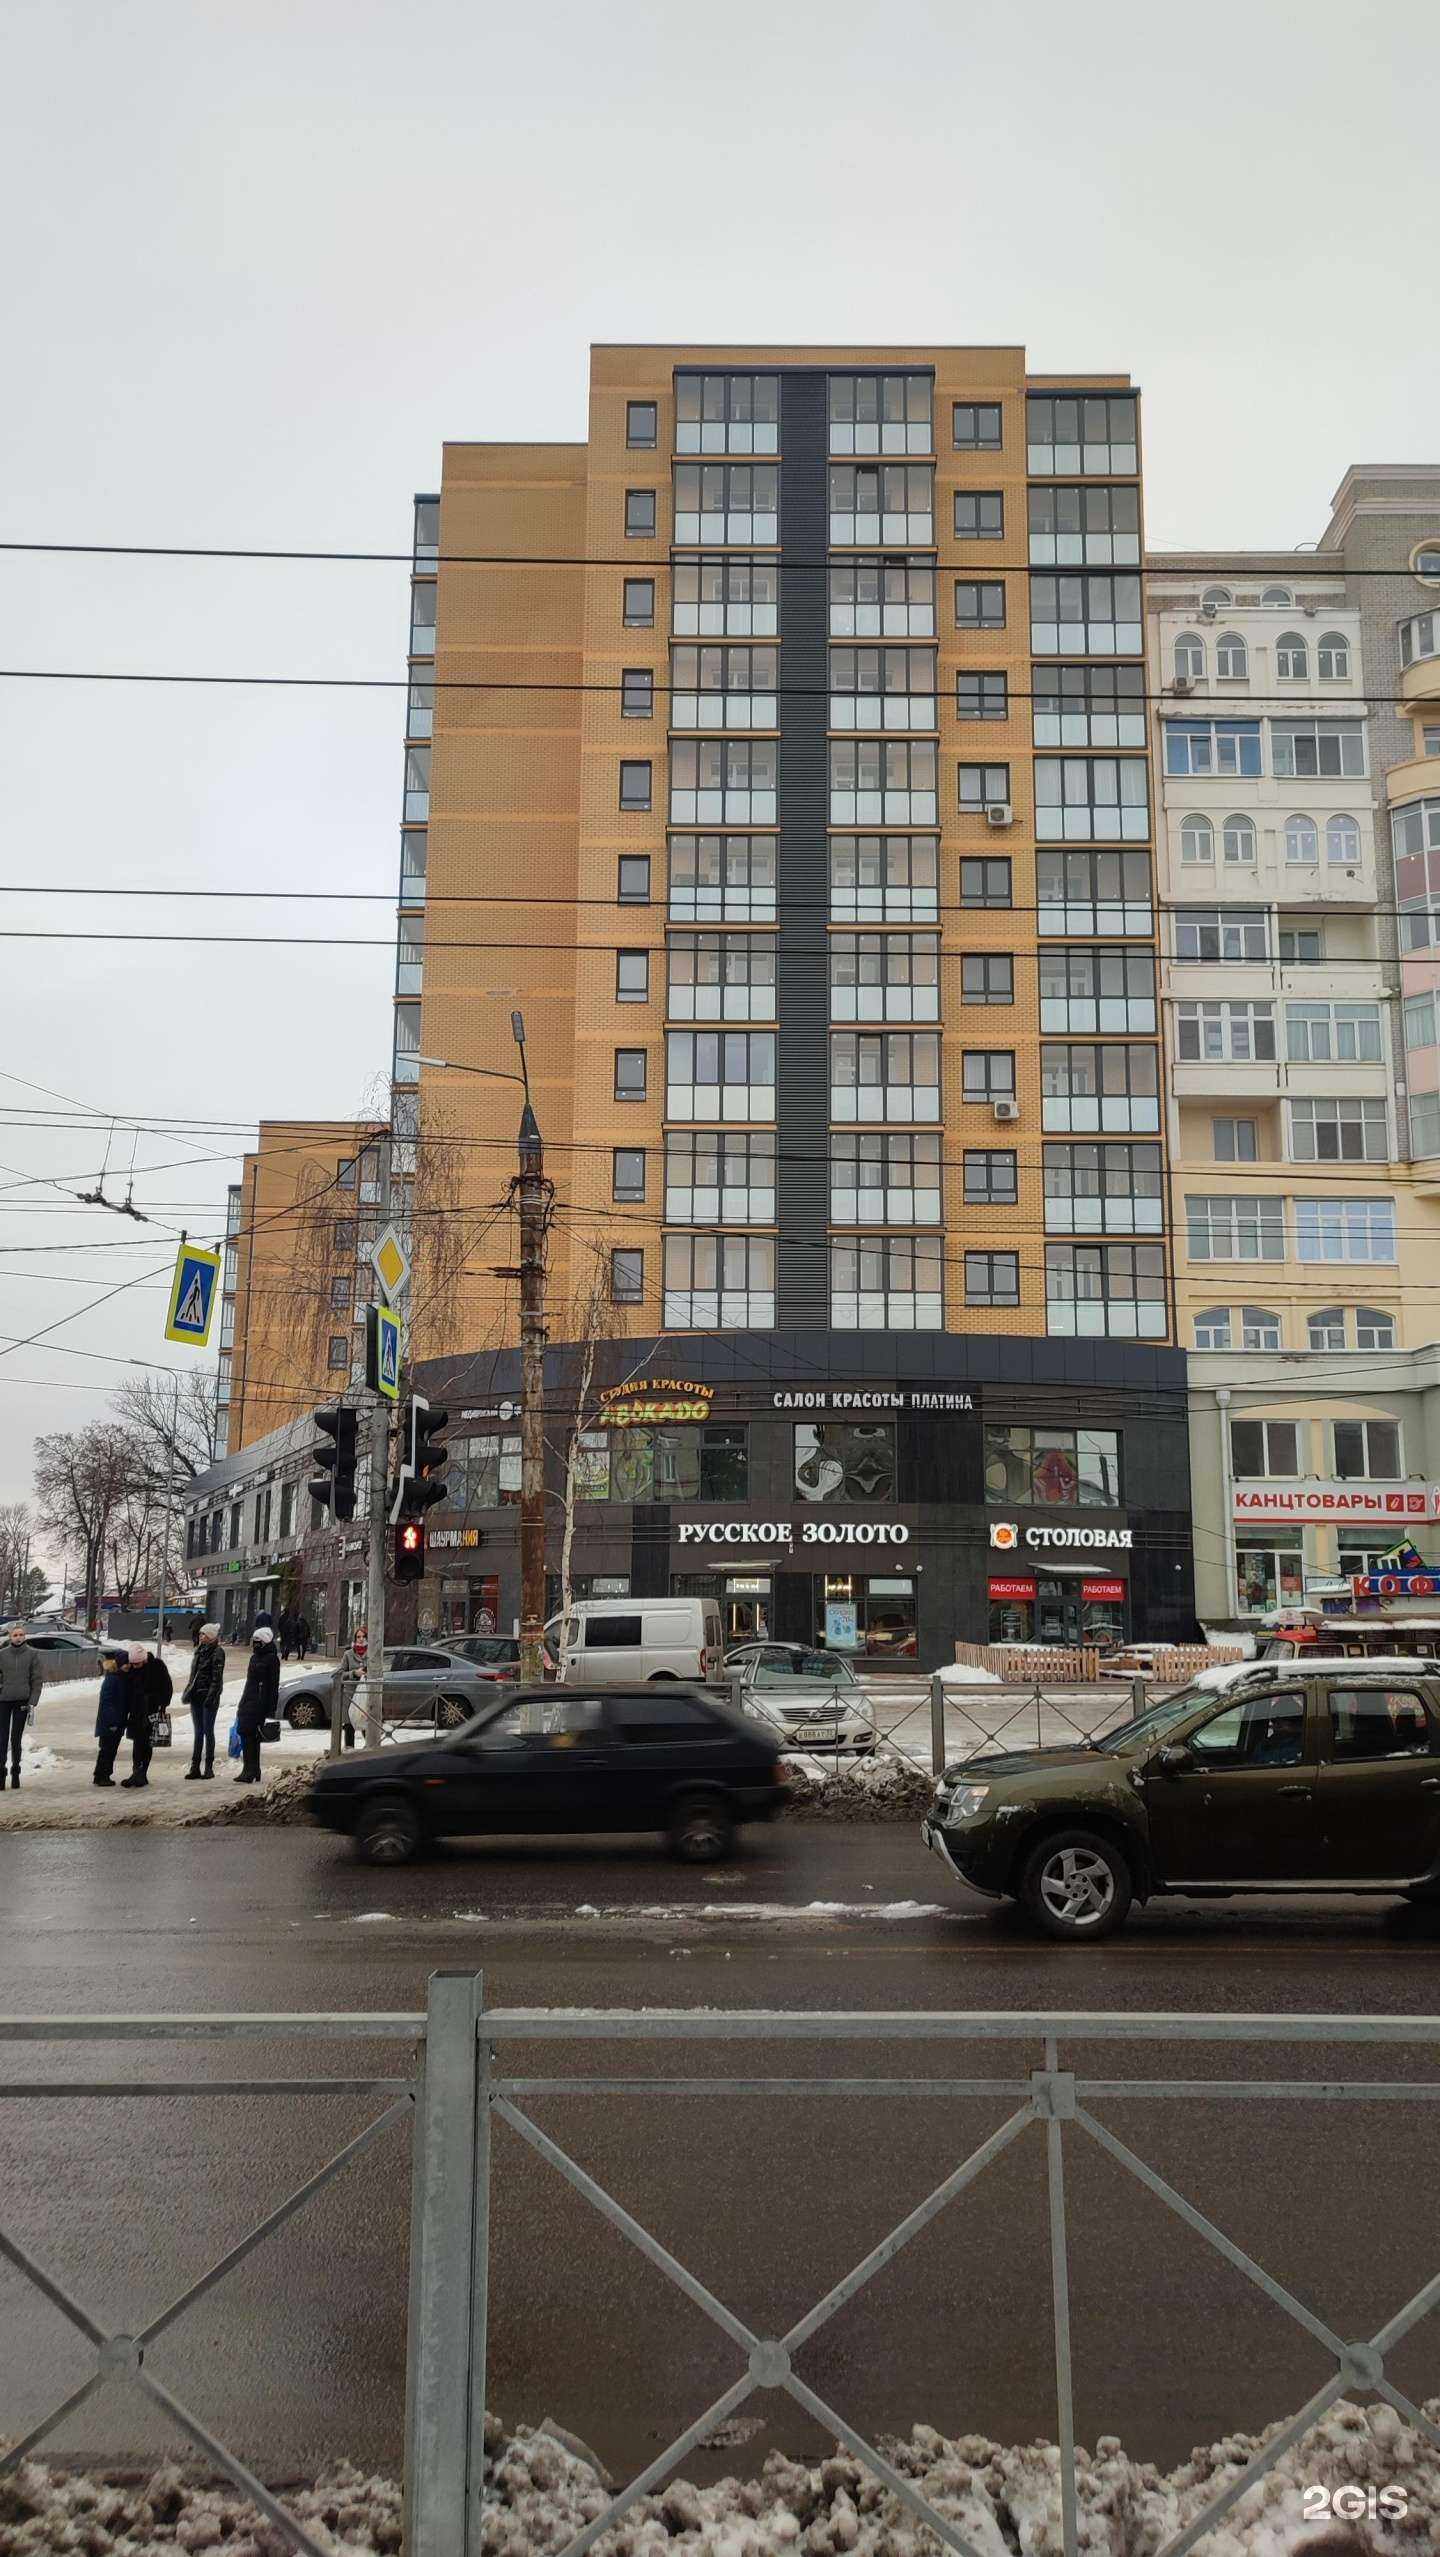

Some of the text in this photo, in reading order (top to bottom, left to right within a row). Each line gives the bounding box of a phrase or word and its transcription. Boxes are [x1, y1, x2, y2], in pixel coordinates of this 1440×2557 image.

[652, 1379, 715, 1399] КРАСОТЫ
[773, 1392, 973, 1410] САЛОН КРАСОТЫ ПЛАТИНА
[1235, 1493, 1382, 1511] КАНЦТОВАРЫ
[429, 1529, 479, 1548] ШАУРМАНИЯ
[678, 1523, 909, 1544] РУССКОЕ ЗОЛОТО
[1025, 1527, 1133, 1548] СТОЛОВАЯ
[990, 1584, 1033, 1593] РАБОТАЕМ
[1083, 1585, 1122, 1594] РАБОТАЕМ
